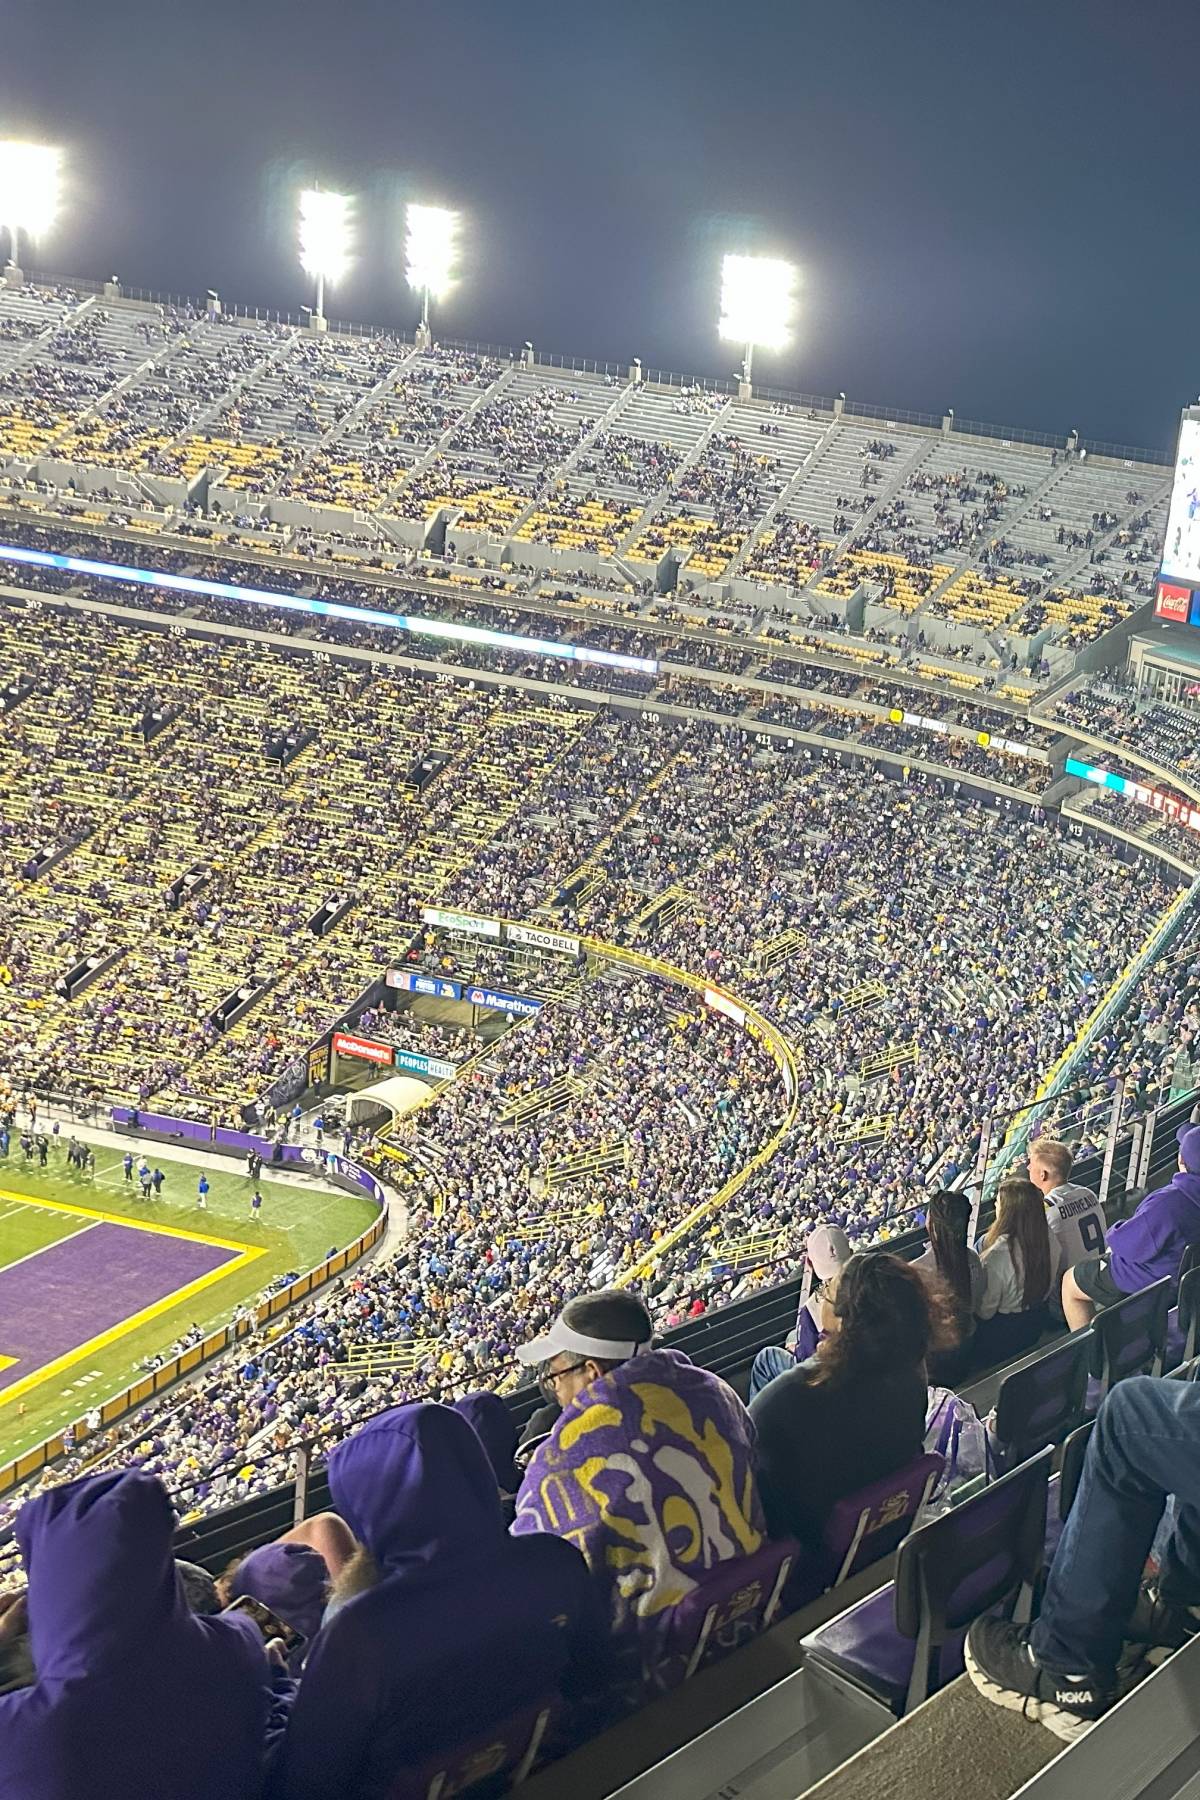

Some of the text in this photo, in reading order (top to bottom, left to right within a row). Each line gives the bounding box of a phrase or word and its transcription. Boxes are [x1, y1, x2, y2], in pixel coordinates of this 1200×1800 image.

[755, 733, 771, 745] 411
[437, 912, 485, 930] EcoSport
[525, 932, 576, 952] TACO BELL
[486, 995, 540, 1016] Marathon
[336, 1039, 390, 1061] McDonald's
[400, 1055, 428, 1072] PEOPLES
[1078, 1212, 1106, 1255] 9
[1055, 1690, 1094, 1704] HOKA
